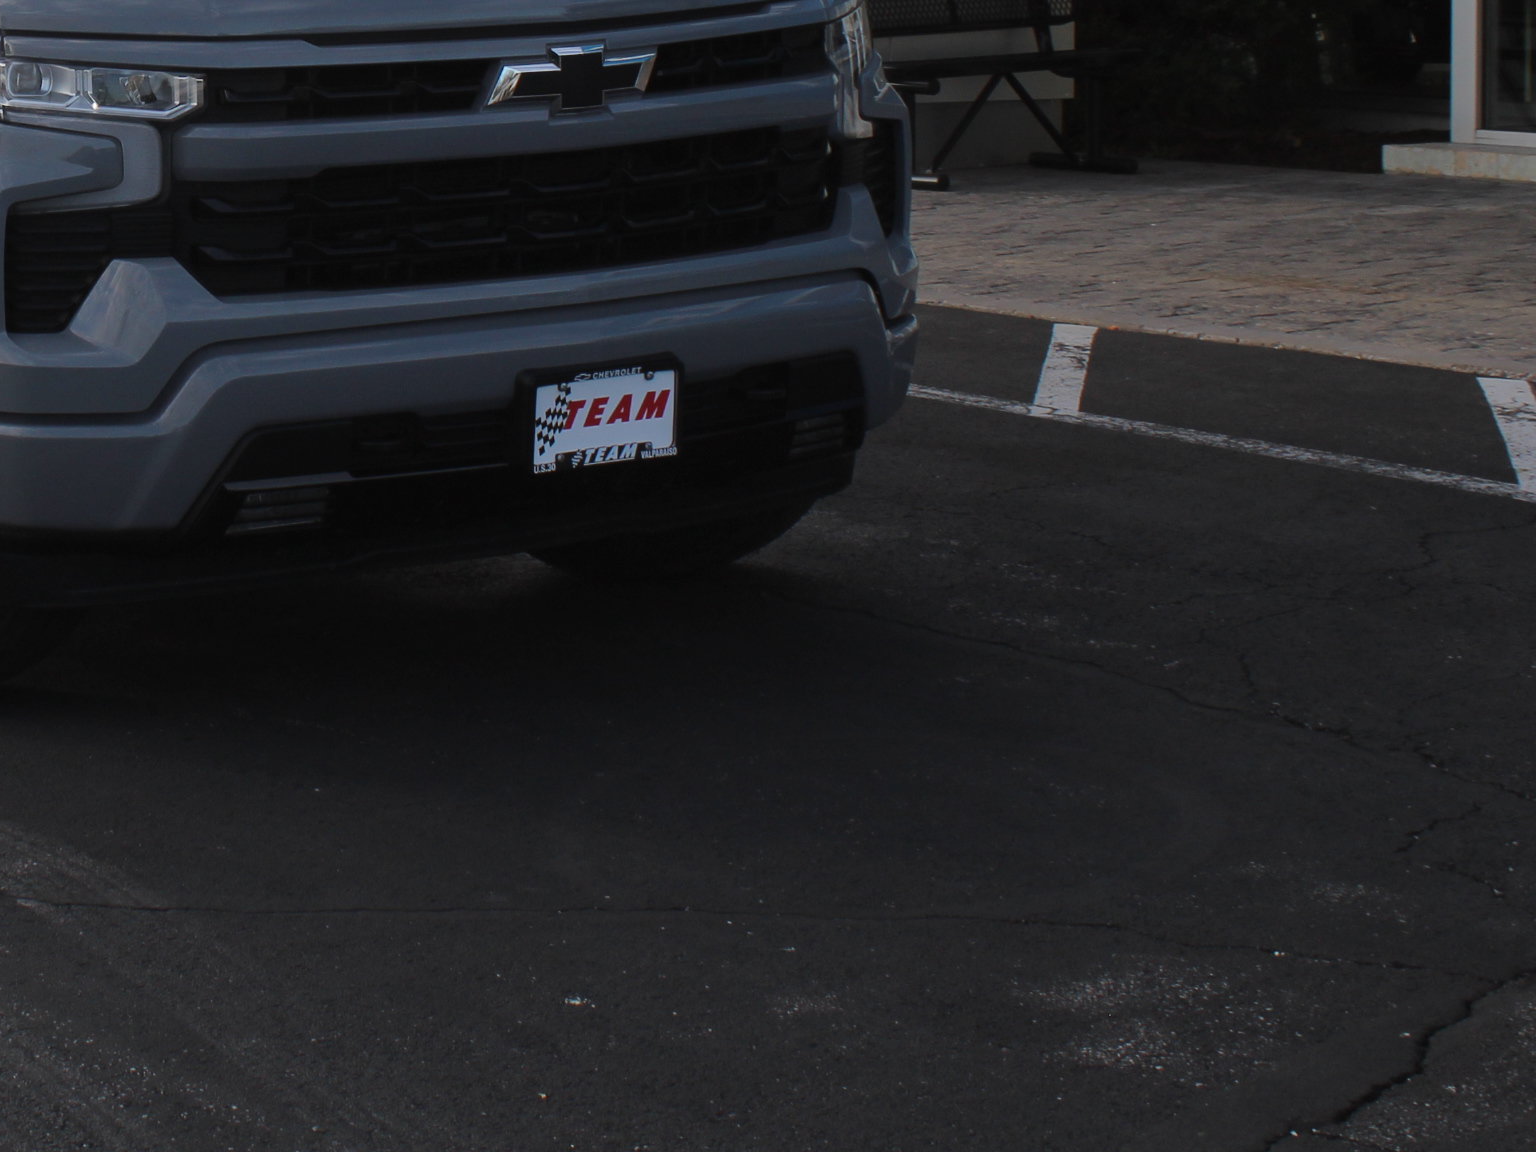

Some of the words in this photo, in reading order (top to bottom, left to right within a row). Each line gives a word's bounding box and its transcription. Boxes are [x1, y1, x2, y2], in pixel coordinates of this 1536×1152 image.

[592, 366, 643, 380] CHEVROLET
[563, 389, 672, 430] TEAM
[583, 442, 639, 465] TEAM
[640, 446, 678, 459] VALPARAISO
